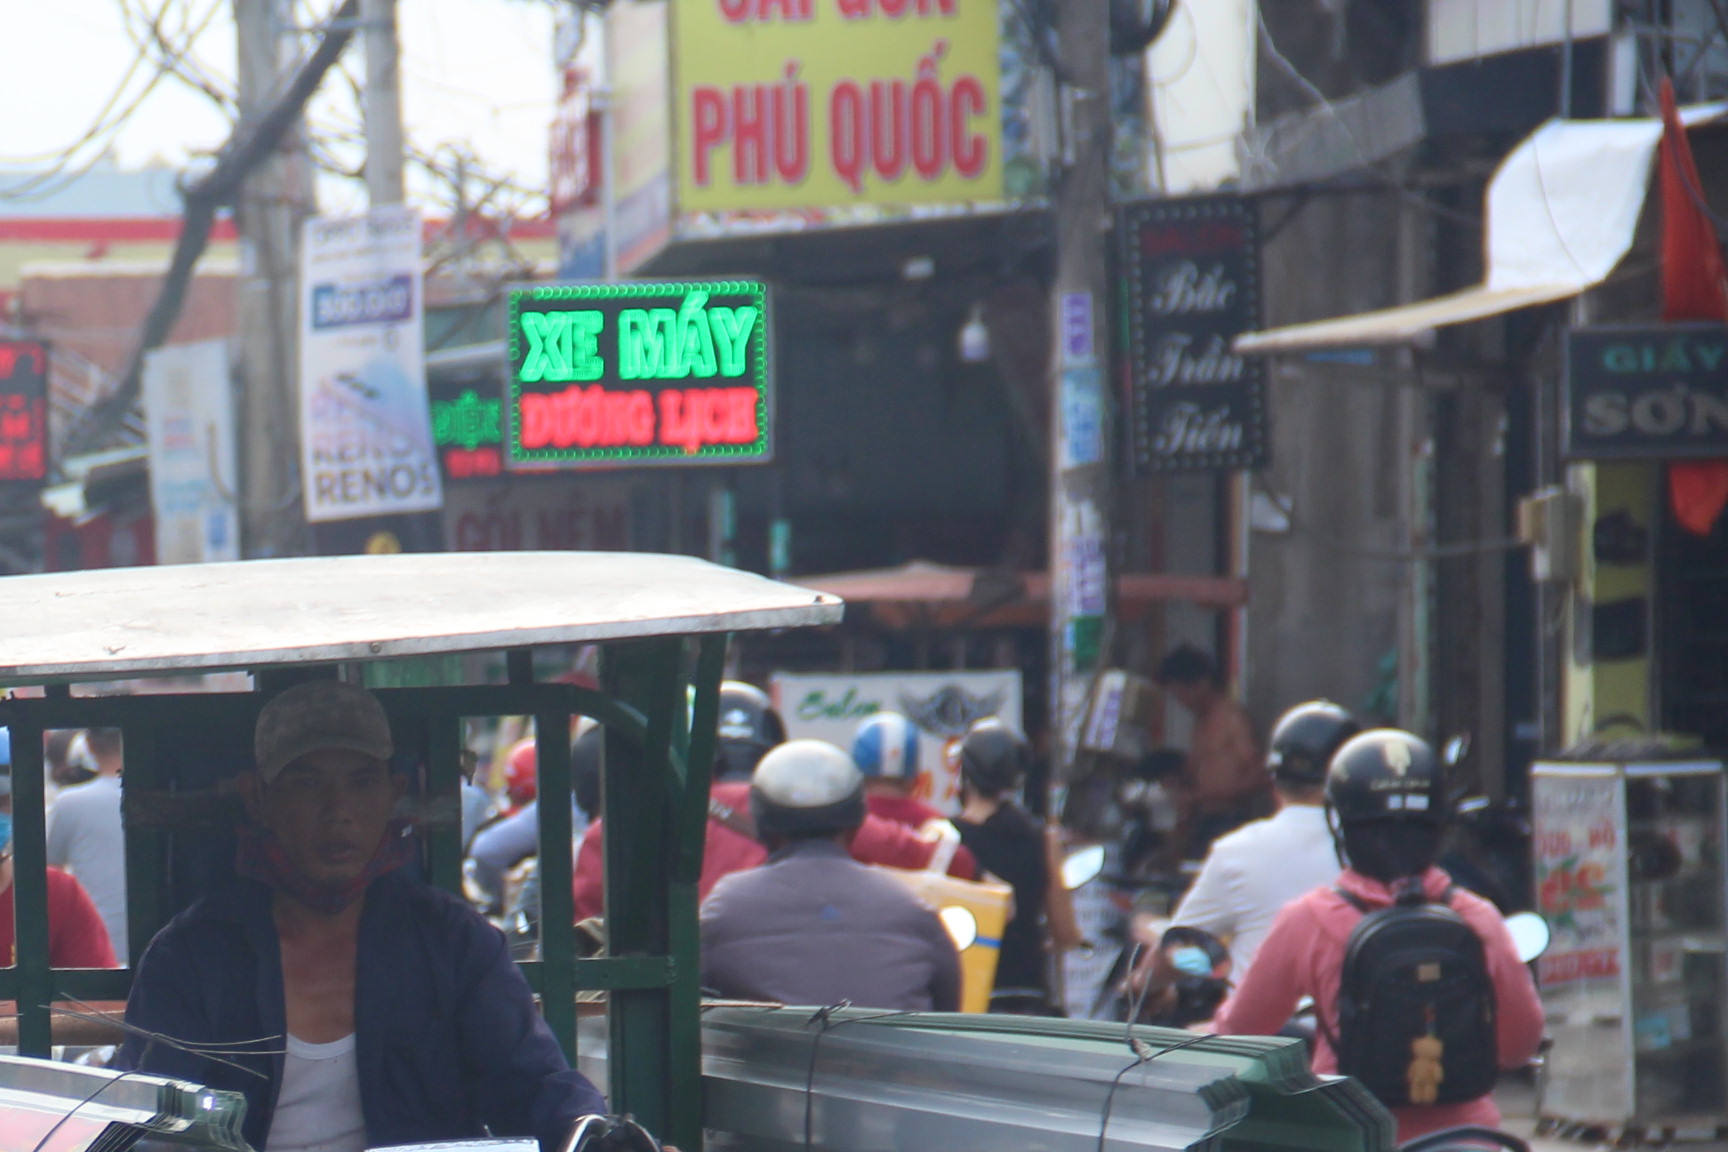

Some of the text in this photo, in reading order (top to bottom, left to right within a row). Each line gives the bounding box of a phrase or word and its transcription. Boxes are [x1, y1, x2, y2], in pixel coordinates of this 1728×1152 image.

[692, 40, 987, 194] PHÚ QUỐC
[520, 291, 758, 382] XE MÁY
